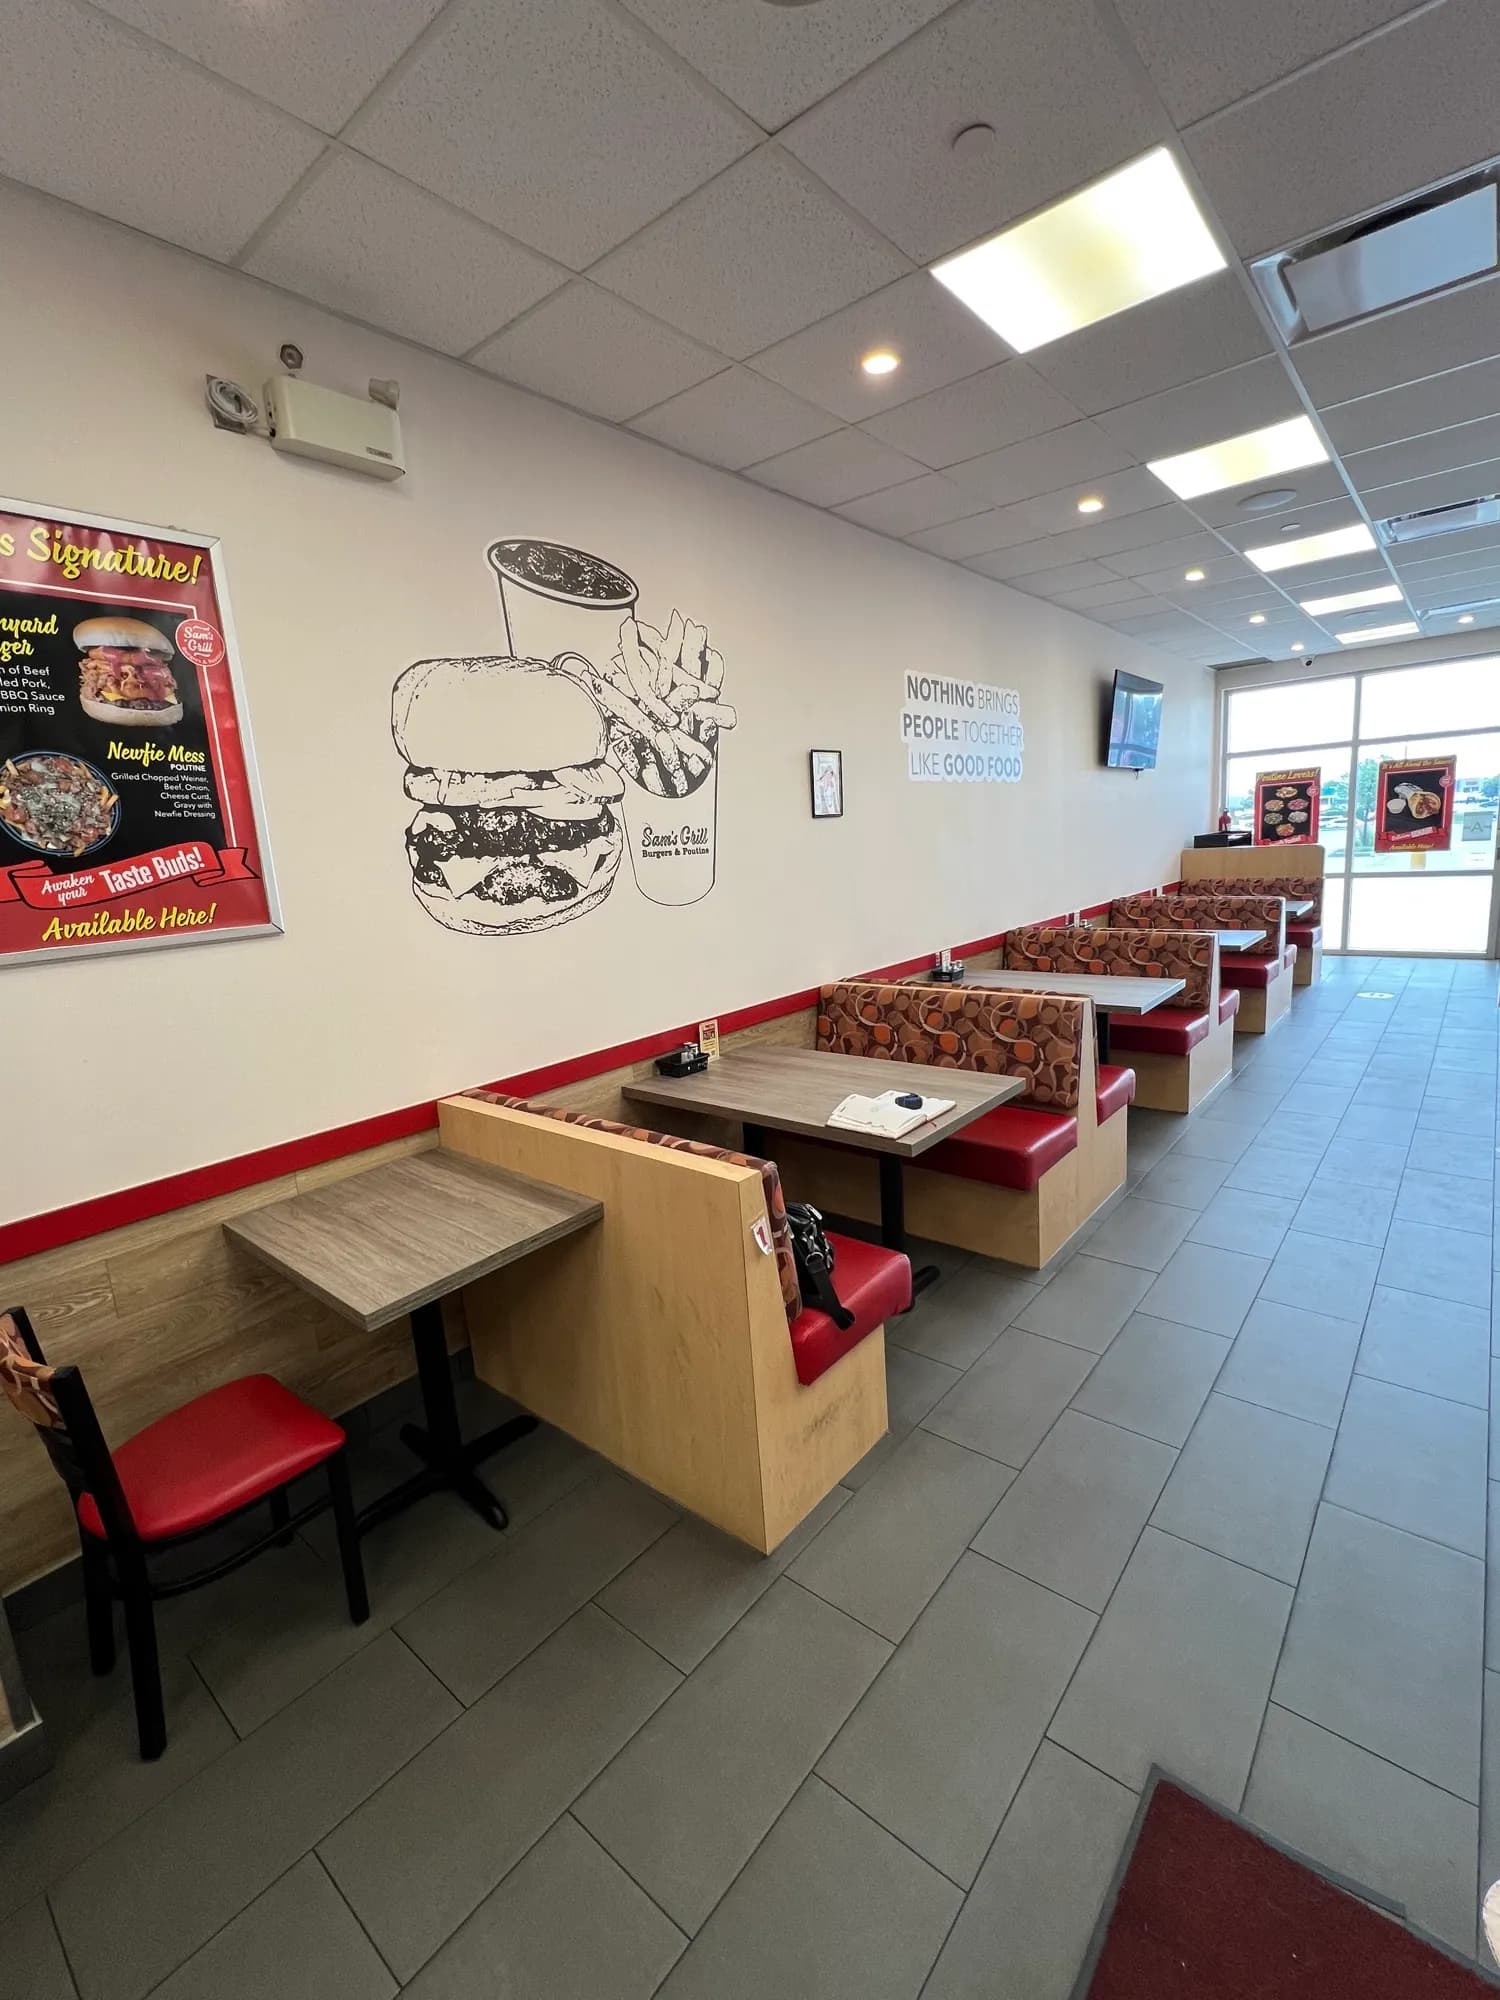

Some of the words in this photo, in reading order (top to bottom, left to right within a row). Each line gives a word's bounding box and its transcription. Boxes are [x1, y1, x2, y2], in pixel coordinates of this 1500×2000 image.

[27, 527, 202, 585] Signature!
[9, 665, 20, 675] of
[23, 665, 50, 676] Beef
[22, 678, 50, 690] Pork,
[1, 690, 29, 700] BBQ
[31, 690, 65, 701] Sauce
[907, 675, 974, 708] NOTHING
[977, 688, 1019, 715] BRINGS
[28, 703, 55, 715] Ring
[903, 713, 959, 741] PEOPLE
[962, 720, 1022, 747] TOGETHER
[107, 741, 166, 767] Newfie
[168, 745, 206, 764] Mess
[170, 763, 207, 772] POUTINE
[911, 751, 940, 776] LIKE
[943, 753, 985, 777] GOOD
[988, 756, 1022, 778] FOOD
[111, 772, 140, 781] Grilled
[141, 773, 179, 783] Chopped
[160, 792, 190, 800] Cheese
[174, 801, 196, 810] Gravy
[184, 811, 216, 820] Dressing
[641, 826, 678, 848] Sam's
[680, 825, 709, 845] Grill
[642, 849, 673, 859] Burgers
[674, 848, 681, 856] &
[683, 847, 709, 855] Poutine
[99, 865, 152, 894] Taste
[152, 846, 205, 880] Buds!
[41, 873, 95, 895] Awaken
[58, 887, 88, 907] your
[42, 908, 156, 942] Available
[159, 902, 217, 929] Here!
